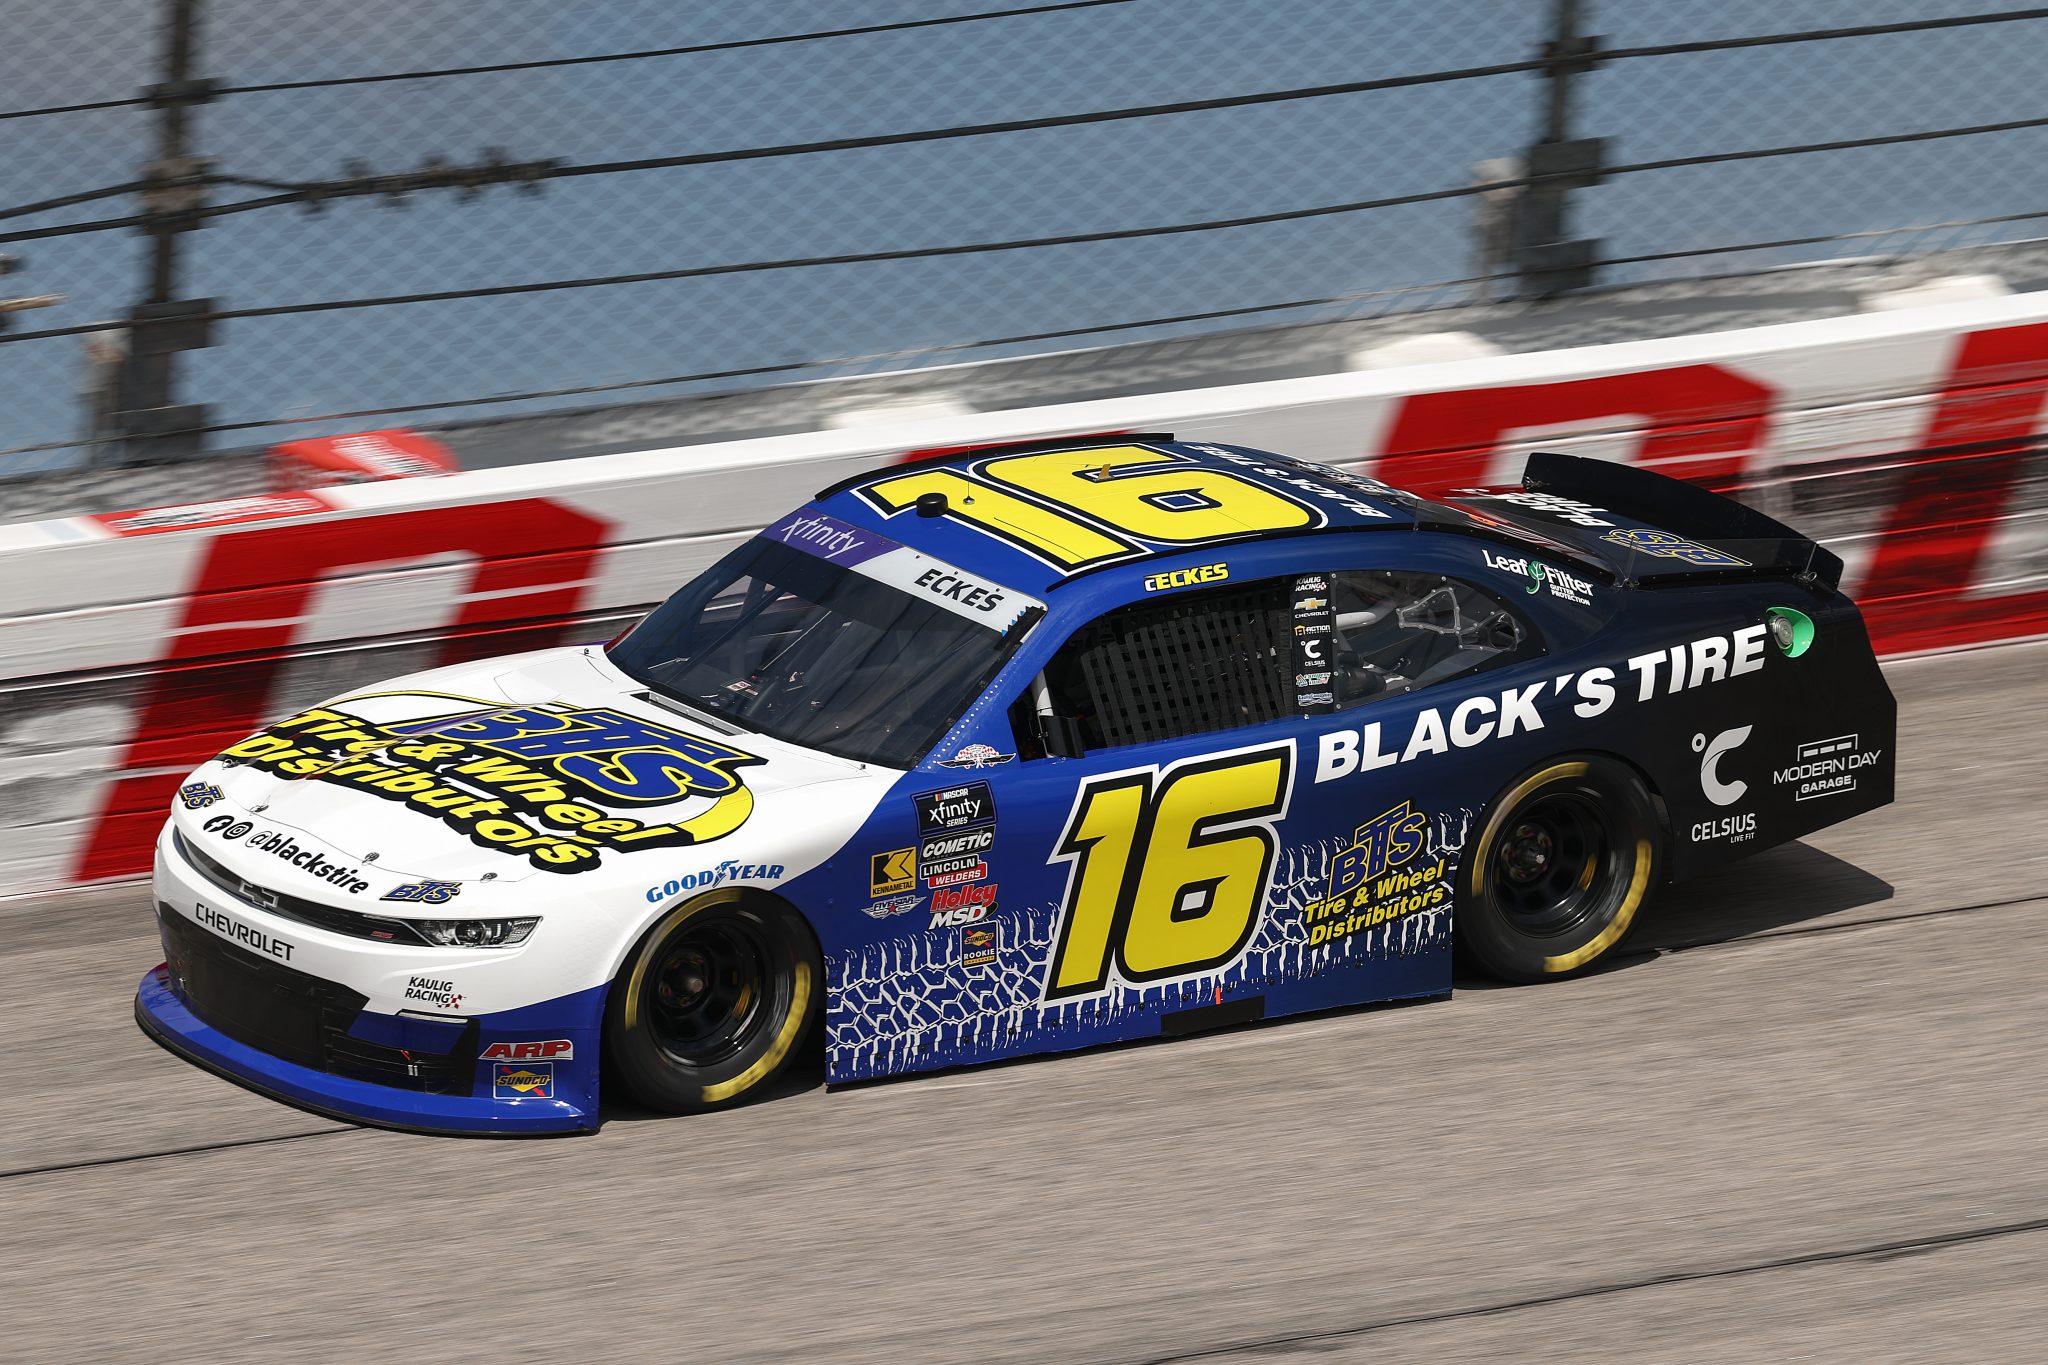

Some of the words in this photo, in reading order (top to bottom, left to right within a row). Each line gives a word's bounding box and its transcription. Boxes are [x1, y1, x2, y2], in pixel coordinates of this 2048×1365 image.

[852, 443, 1328, 575] 16
[781, 516, 864, 558] xfinity
[914, 568, 1004, 612] ECKES
[1315, 665, 1616, 784] BLACK'S
[1627, 623, 1767, 702] TIRE
[384, 707, 758, 804] BTS
[1774, 757, 1845, 785] MODERN
[1848, 749, 1882, 769] DAY
[276, 709, 387, 753] Tire
[391, 741, 467, 763] &
[455, 755, 680, 843] Wheel
[1801, 775, 1852, 793] GARAGE
[179, 781, 225, 810] BTS
[222, 734, 594, 865] Distributors
[943, 788, 968, 799] NASCAR
[929, 798, 981, 824] xfinity
[946, 816, 968, 827] SERIES
[1692, 813, 1756, 842] CELSIUS
[1730, 834, 1743, 843] LIVE
[1745, 832, 1754, 841] FIT
[923, 832, 993, 857] COMETIC
[1328, 800, 1426, 902] BTS
[245, 831, 369, 894] @blackstire
[923, 858, 975, 877] LINCOLN
[1043, 744, 1292, 1003] 16
[646, 862, 784, 902] GOODYEAR
[873, 881, 914, 896] KENNAMETAL
[935, 870, 981, 885] WELDERS
[380, 880, 462, 904] BTS
[931, 884, 998, 911] Holley
[1304, 898, 1346, 924] Tire
[1353, 886, 1369, 907] &
[1377, 859, 1445, 899] Wheel
[929, 905, 988, 930] MSD
[1310, 887, 1444, 946] Distributors
[196, 903, 294, 961] CHEVROLET
[966, 933, 994, 944] SUNOCO
[963, 949, 995, 960] ROOKIE
[405, 988, 450, 1004] RACING
[409, 976, 453, 992] KAULIG
[482, 1041, 572, 1059] ARP
[499, 1075, 549, 1086] SUNOCO
